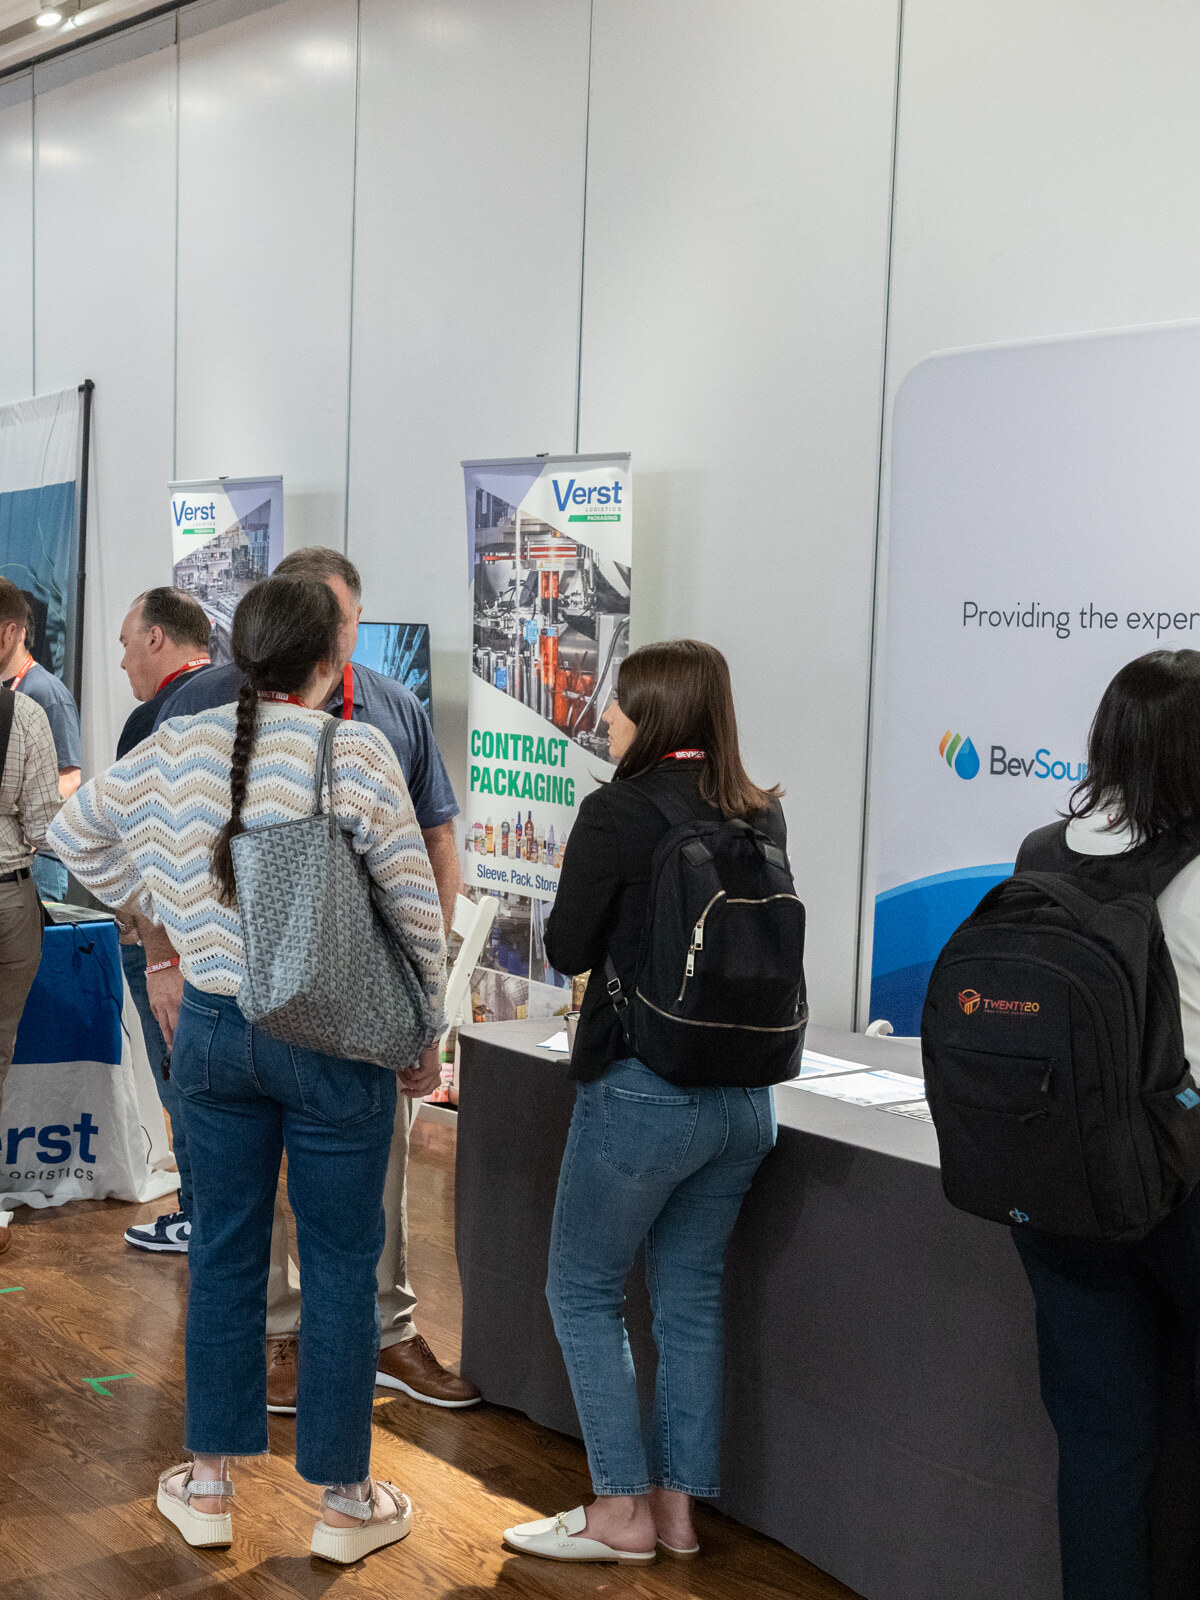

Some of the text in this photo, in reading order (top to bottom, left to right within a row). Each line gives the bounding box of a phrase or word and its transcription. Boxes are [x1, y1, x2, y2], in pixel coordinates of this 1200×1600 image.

[552, 479, 622, 512] Verst
[173, 501, 215, 526] Verst
[963, 601, 1200, 639] Providing the exper
[471, 729, 568, 767] CONTRACT
[470, 765, 575, 807] PACKAGING
[477, 864, 509, 883] Sleeve.
[510, 869, 534, 888] Pack.
[983, 999, 1040, 1012] TWENTY20
